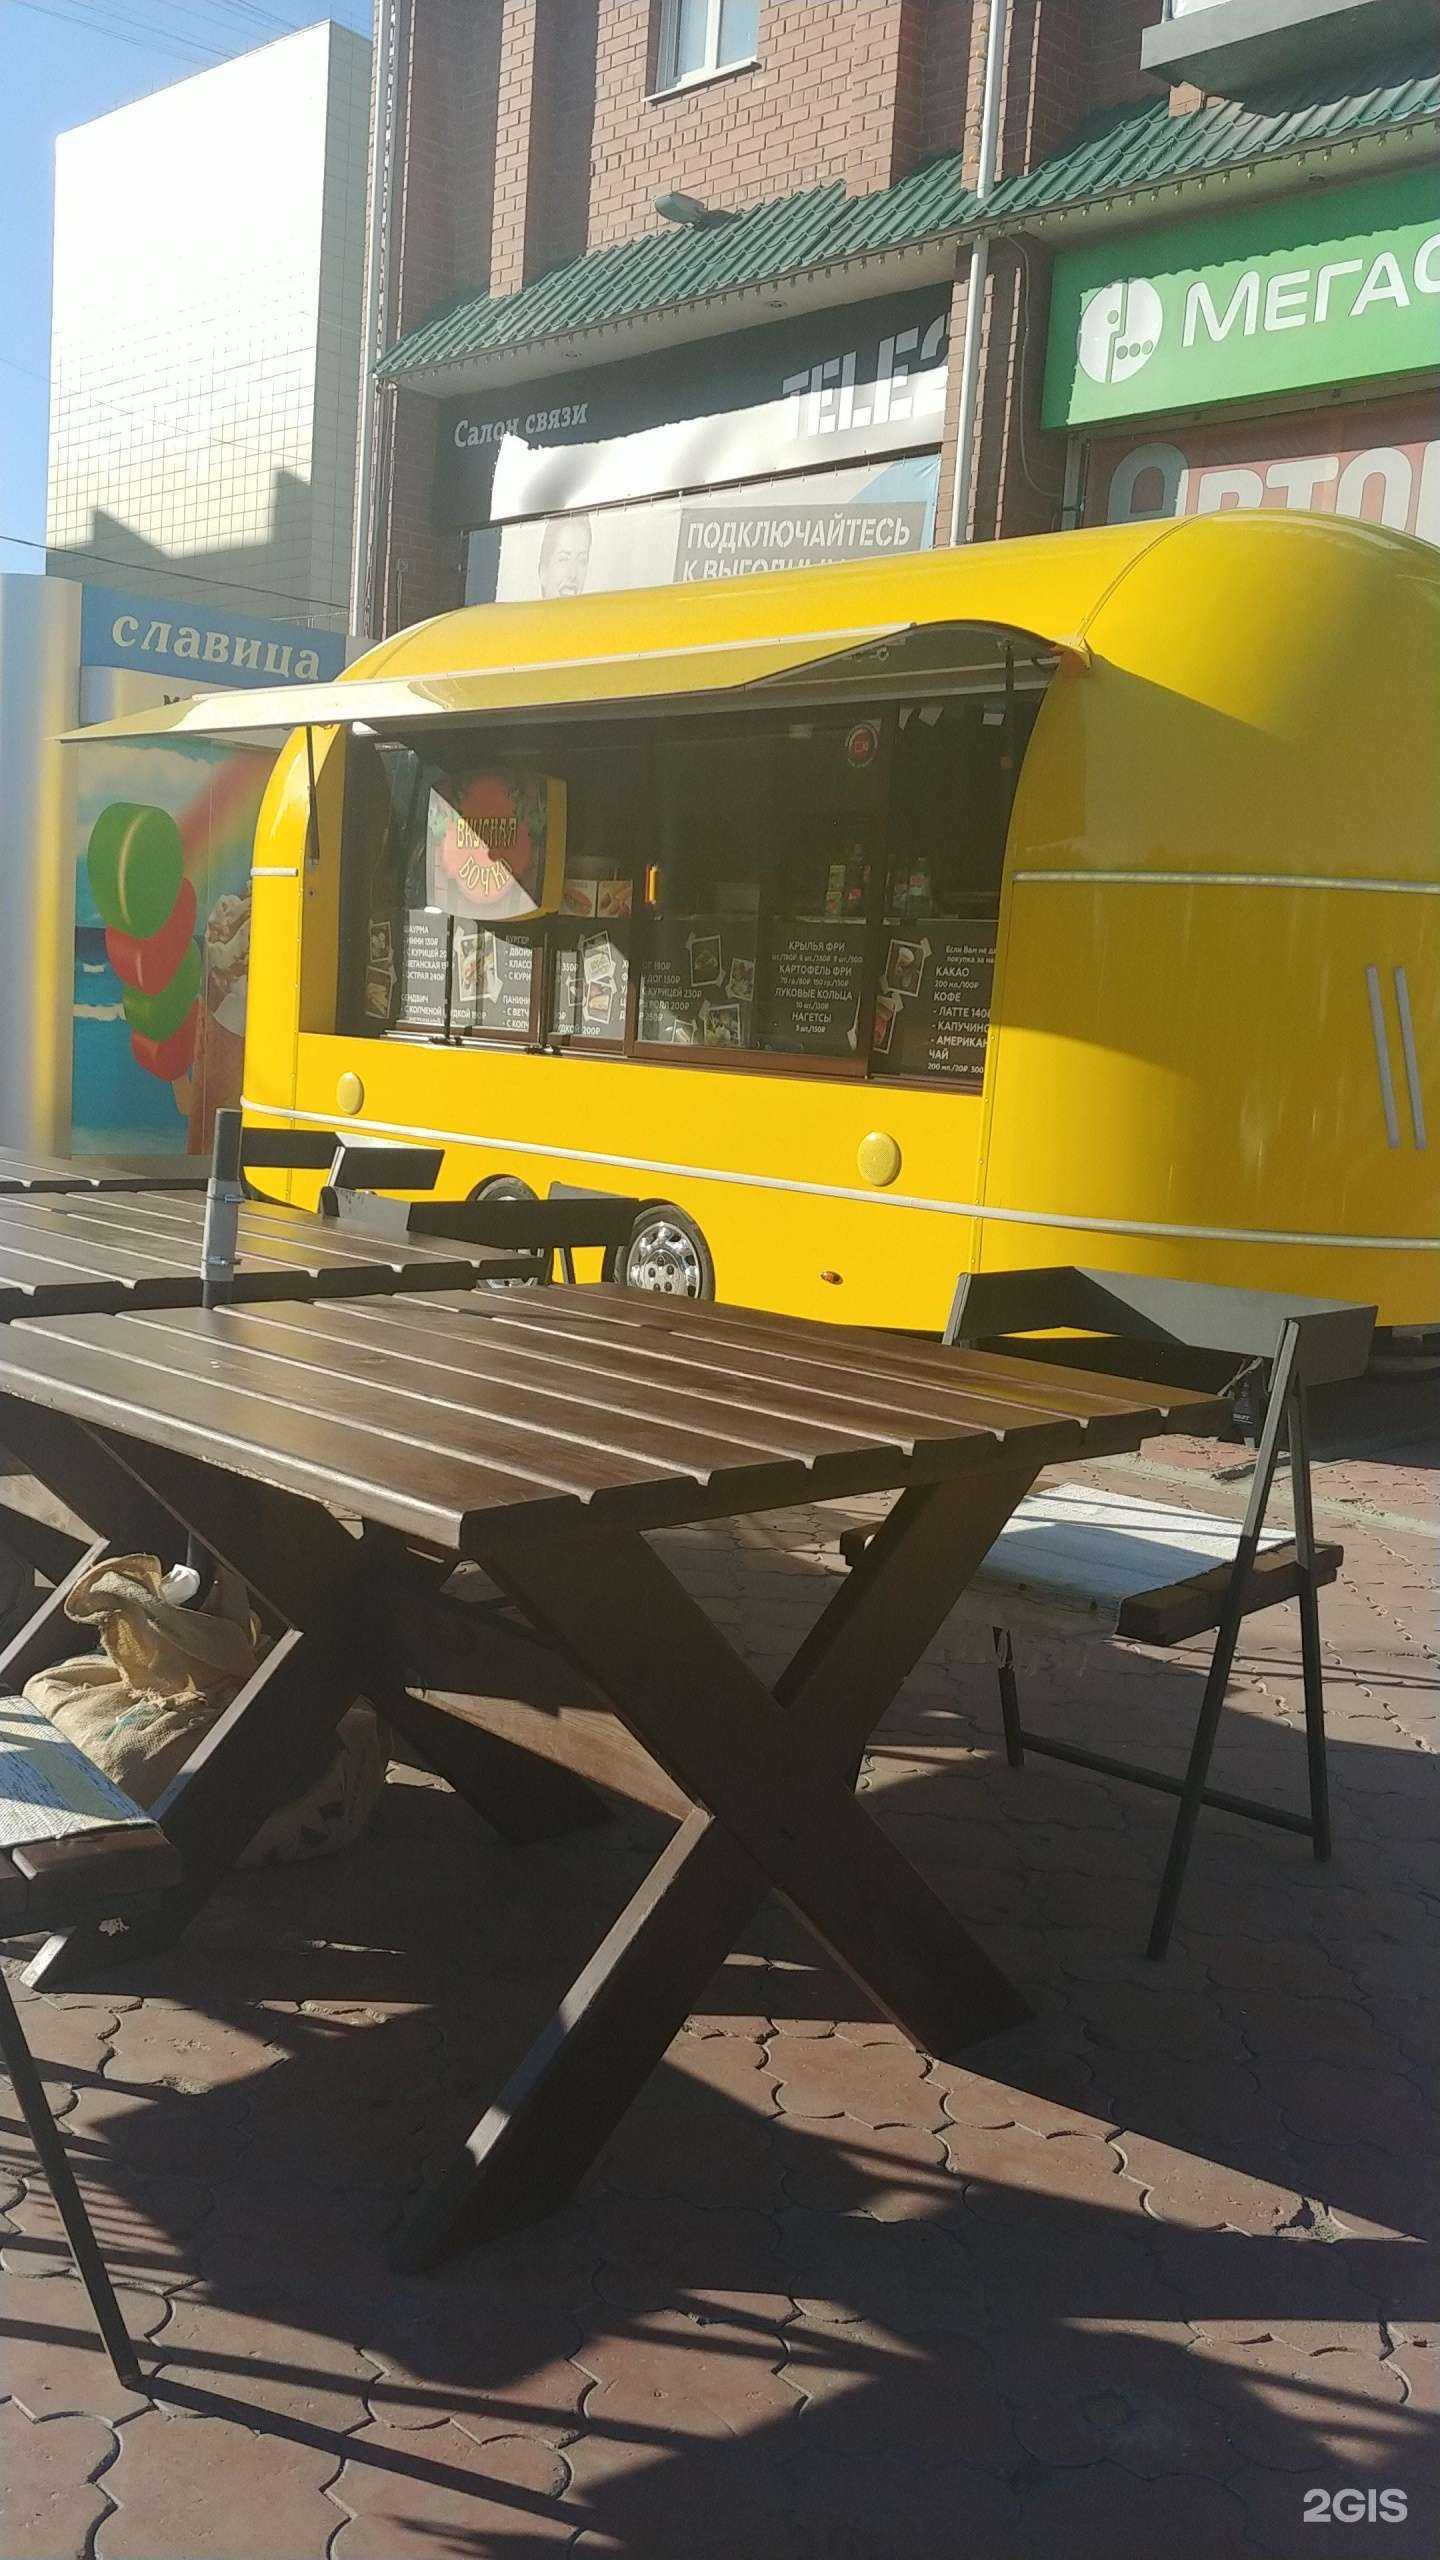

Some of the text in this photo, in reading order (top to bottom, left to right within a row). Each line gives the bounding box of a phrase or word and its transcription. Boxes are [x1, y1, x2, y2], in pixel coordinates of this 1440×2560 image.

[454, 403, 589, 448] Салон связи
[687, 512, 911, 554] ПОДКЛЮЧАЙТЕСЬ
[112, 615, 320, 681] славица
[825, 942, 845, 952] ФРИ
[936, 967, 970, 977] КАКАО
[934, 992, 961, 1002] КОФЕ
[939, 1006, 970, 1017] ЛАТТЕ
[935, 1035, 988, 1048] АМЕРИКАН
[928, 1048, 949, 1060] ЧАЙ
